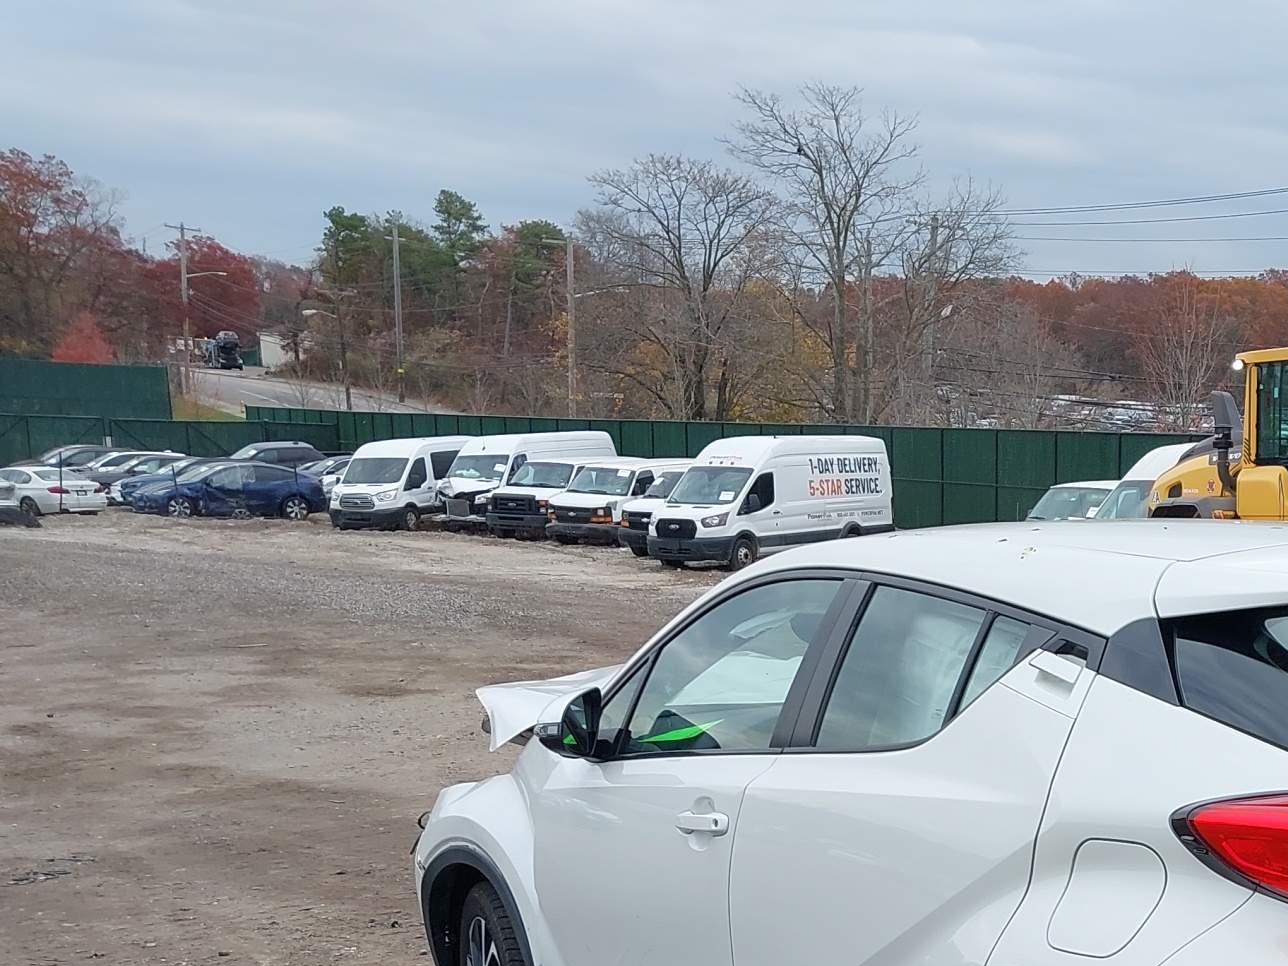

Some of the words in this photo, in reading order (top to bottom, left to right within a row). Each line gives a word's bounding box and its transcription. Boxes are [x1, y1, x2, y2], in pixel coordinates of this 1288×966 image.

[809, 458, 834, 475] 1-DAY
[808, 479, 843, 497] 5-STAR
[844, 477, 883, 494] SERVICE.
